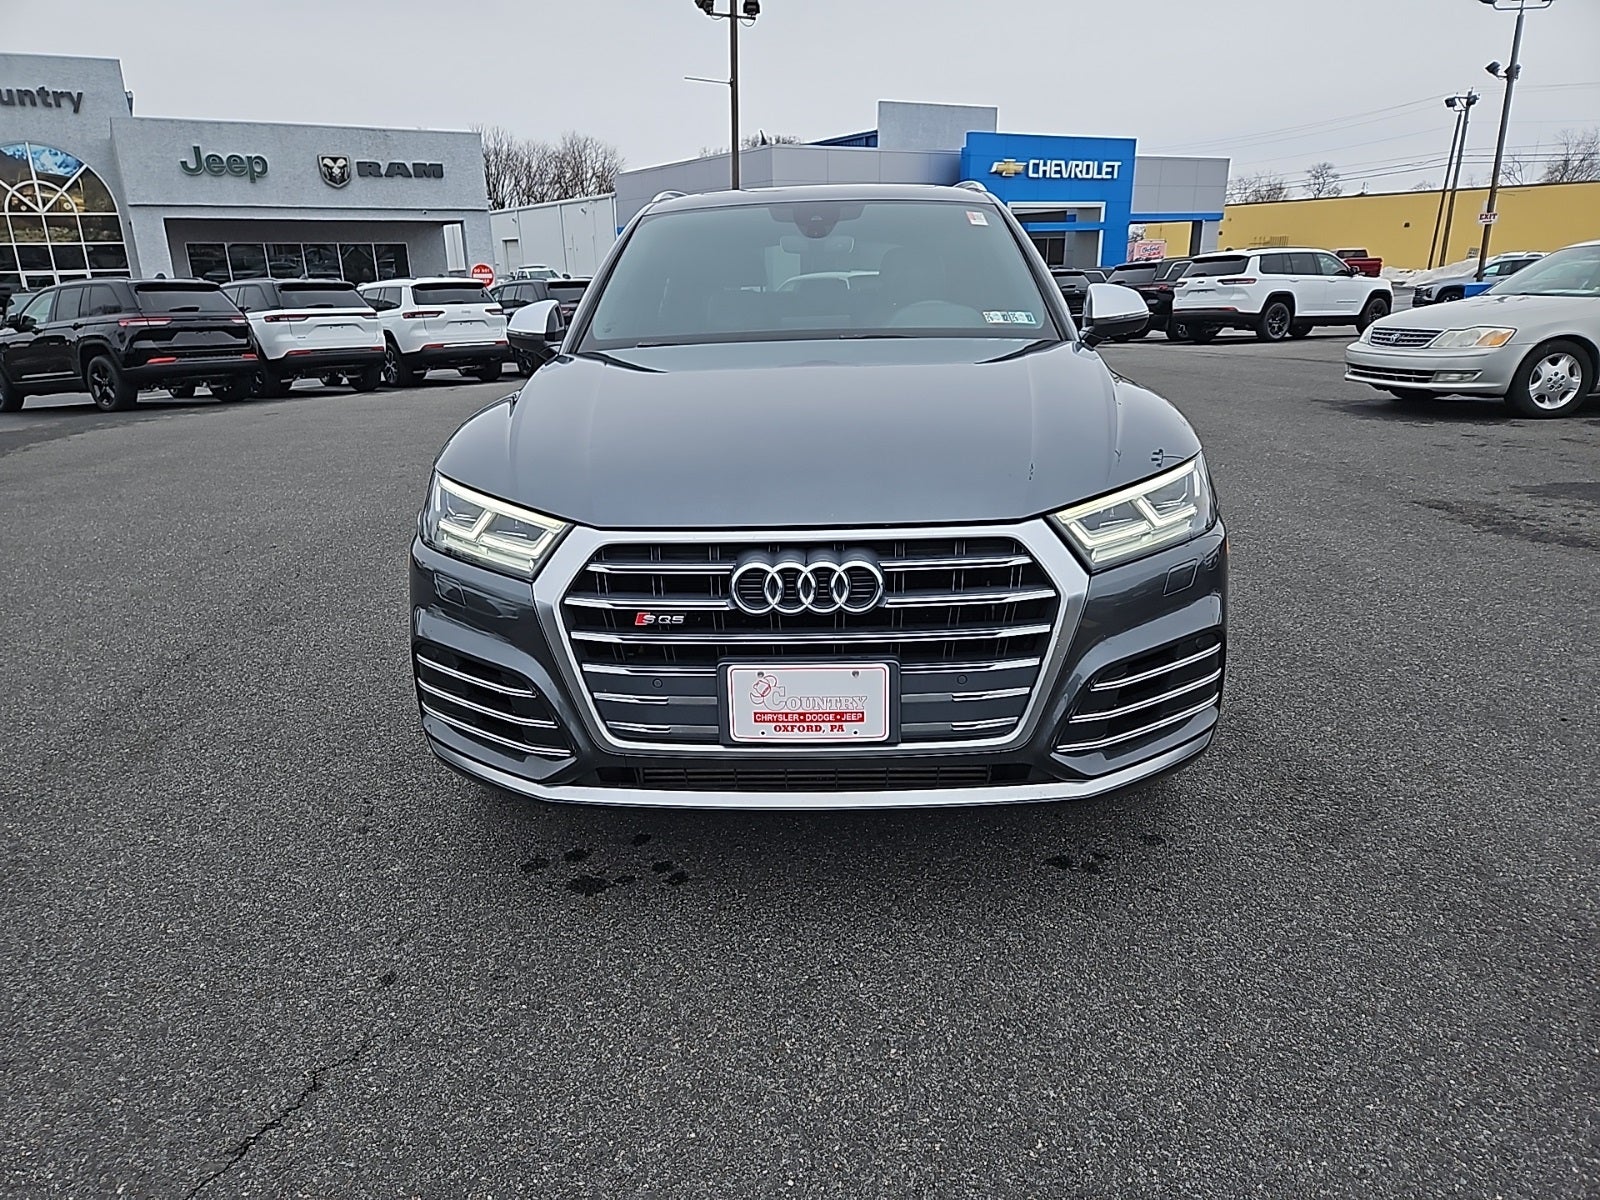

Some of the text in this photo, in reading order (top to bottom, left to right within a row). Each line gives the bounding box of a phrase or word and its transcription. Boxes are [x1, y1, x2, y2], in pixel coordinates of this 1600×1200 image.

[179, 144, 268, 183] Jeep
[356, 161, 444, 178] RAM
[1028, 160, 1122, 179] CHEVROLET
[755, 712, 863, 722] CHRYSLER DODGE JEEP
[773, 724, 845, 734] OXFORD, PA
